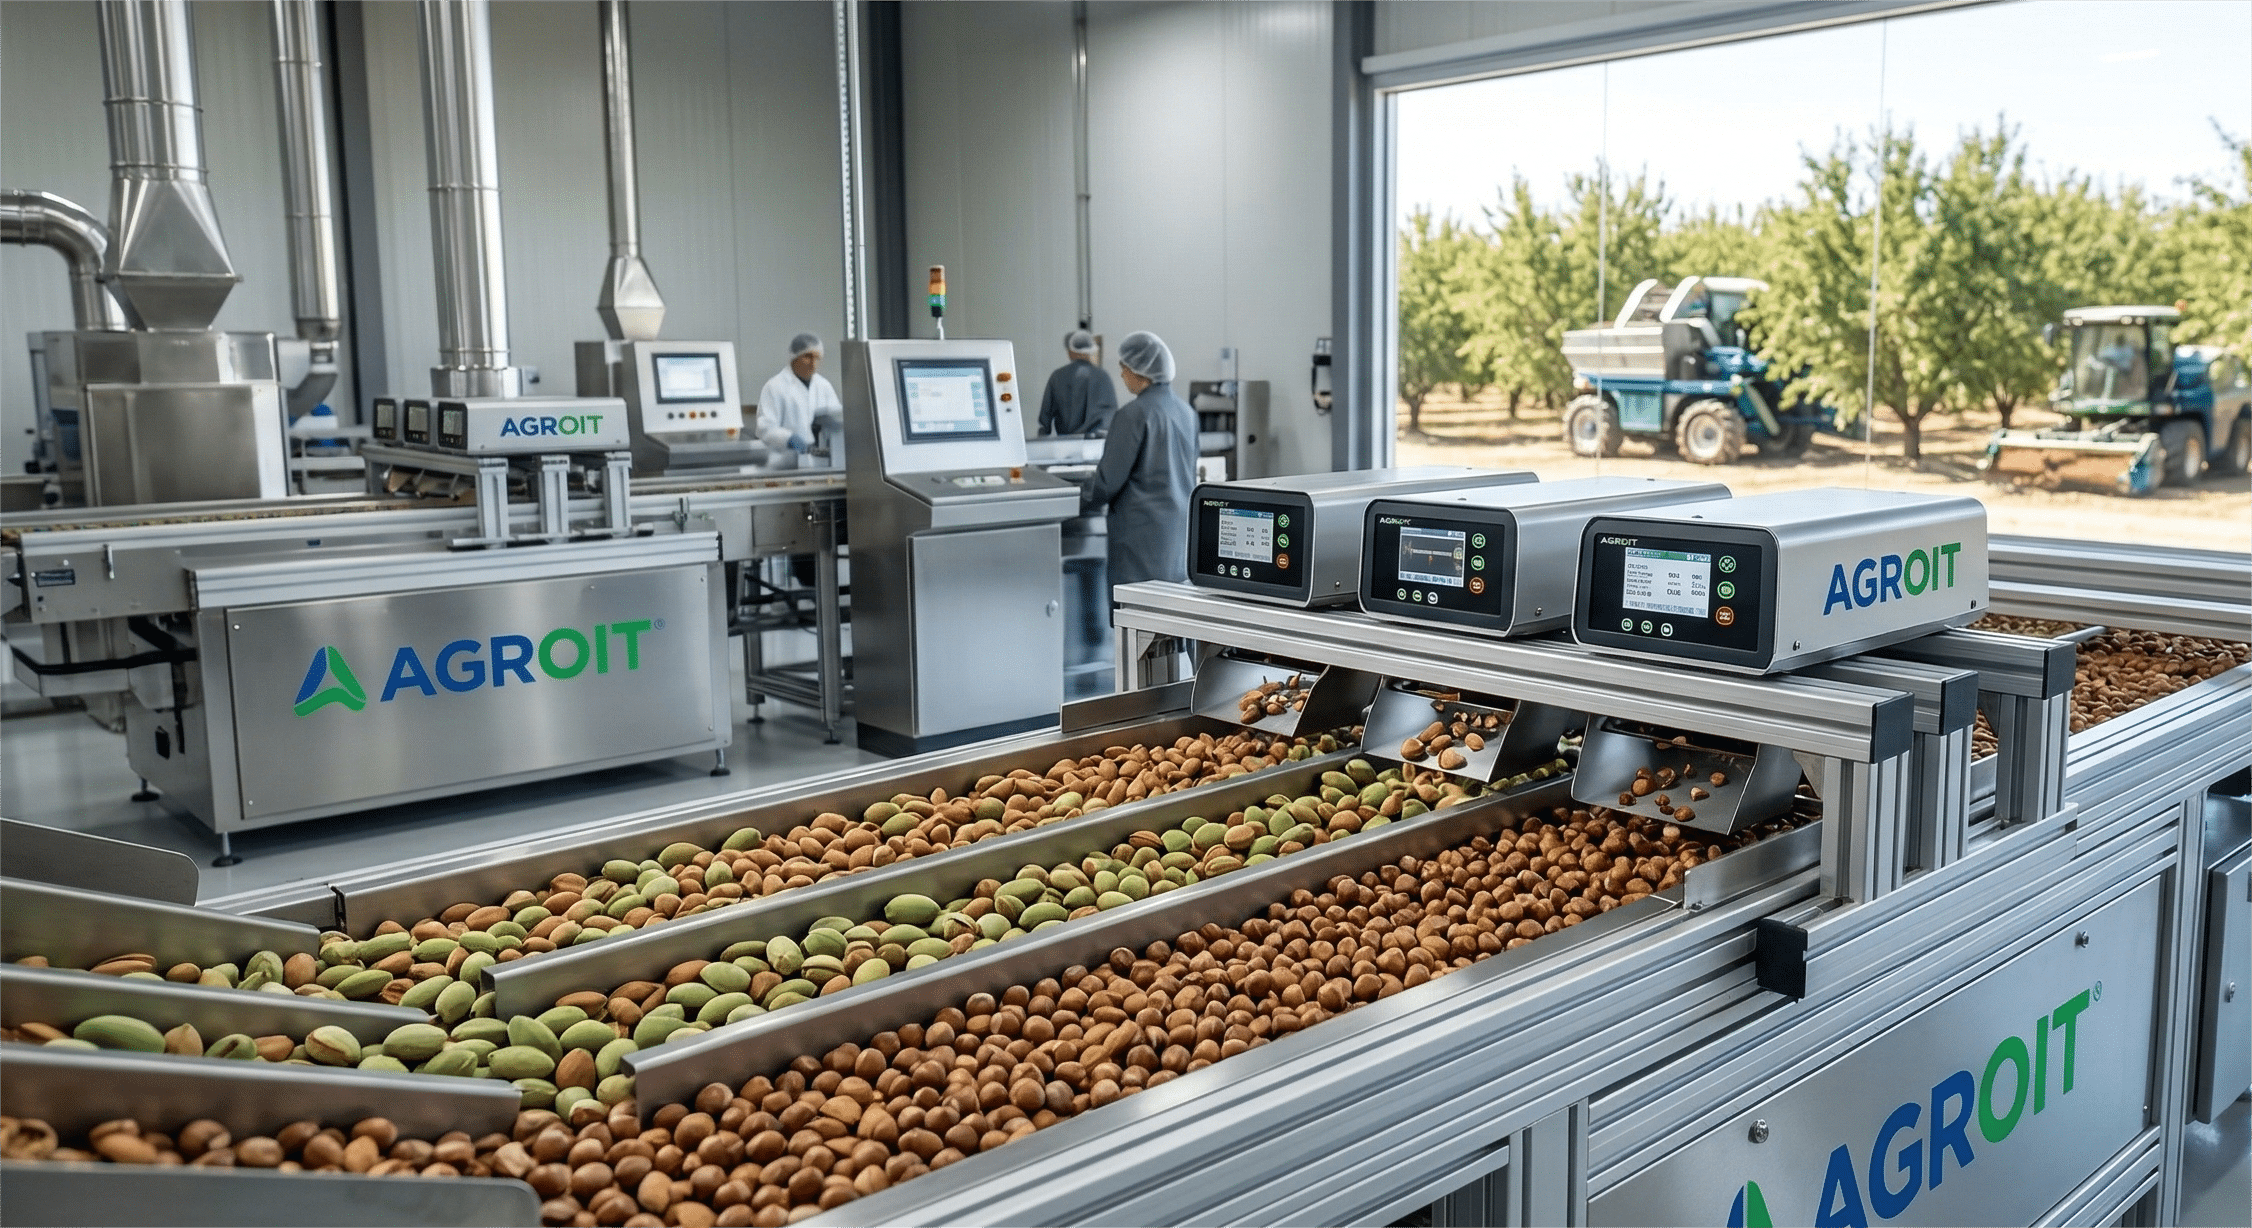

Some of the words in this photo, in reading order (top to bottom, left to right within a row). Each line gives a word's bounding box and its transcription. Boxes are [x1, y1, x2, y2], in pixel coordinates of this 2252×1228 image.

[500, 415, 603, 437] AGROIT
[1823, 542, 1961, 615] AGROIT
[380, 619, 652, 702] AGROIT
[1815, 988, 2091, 1228] AGROIT
